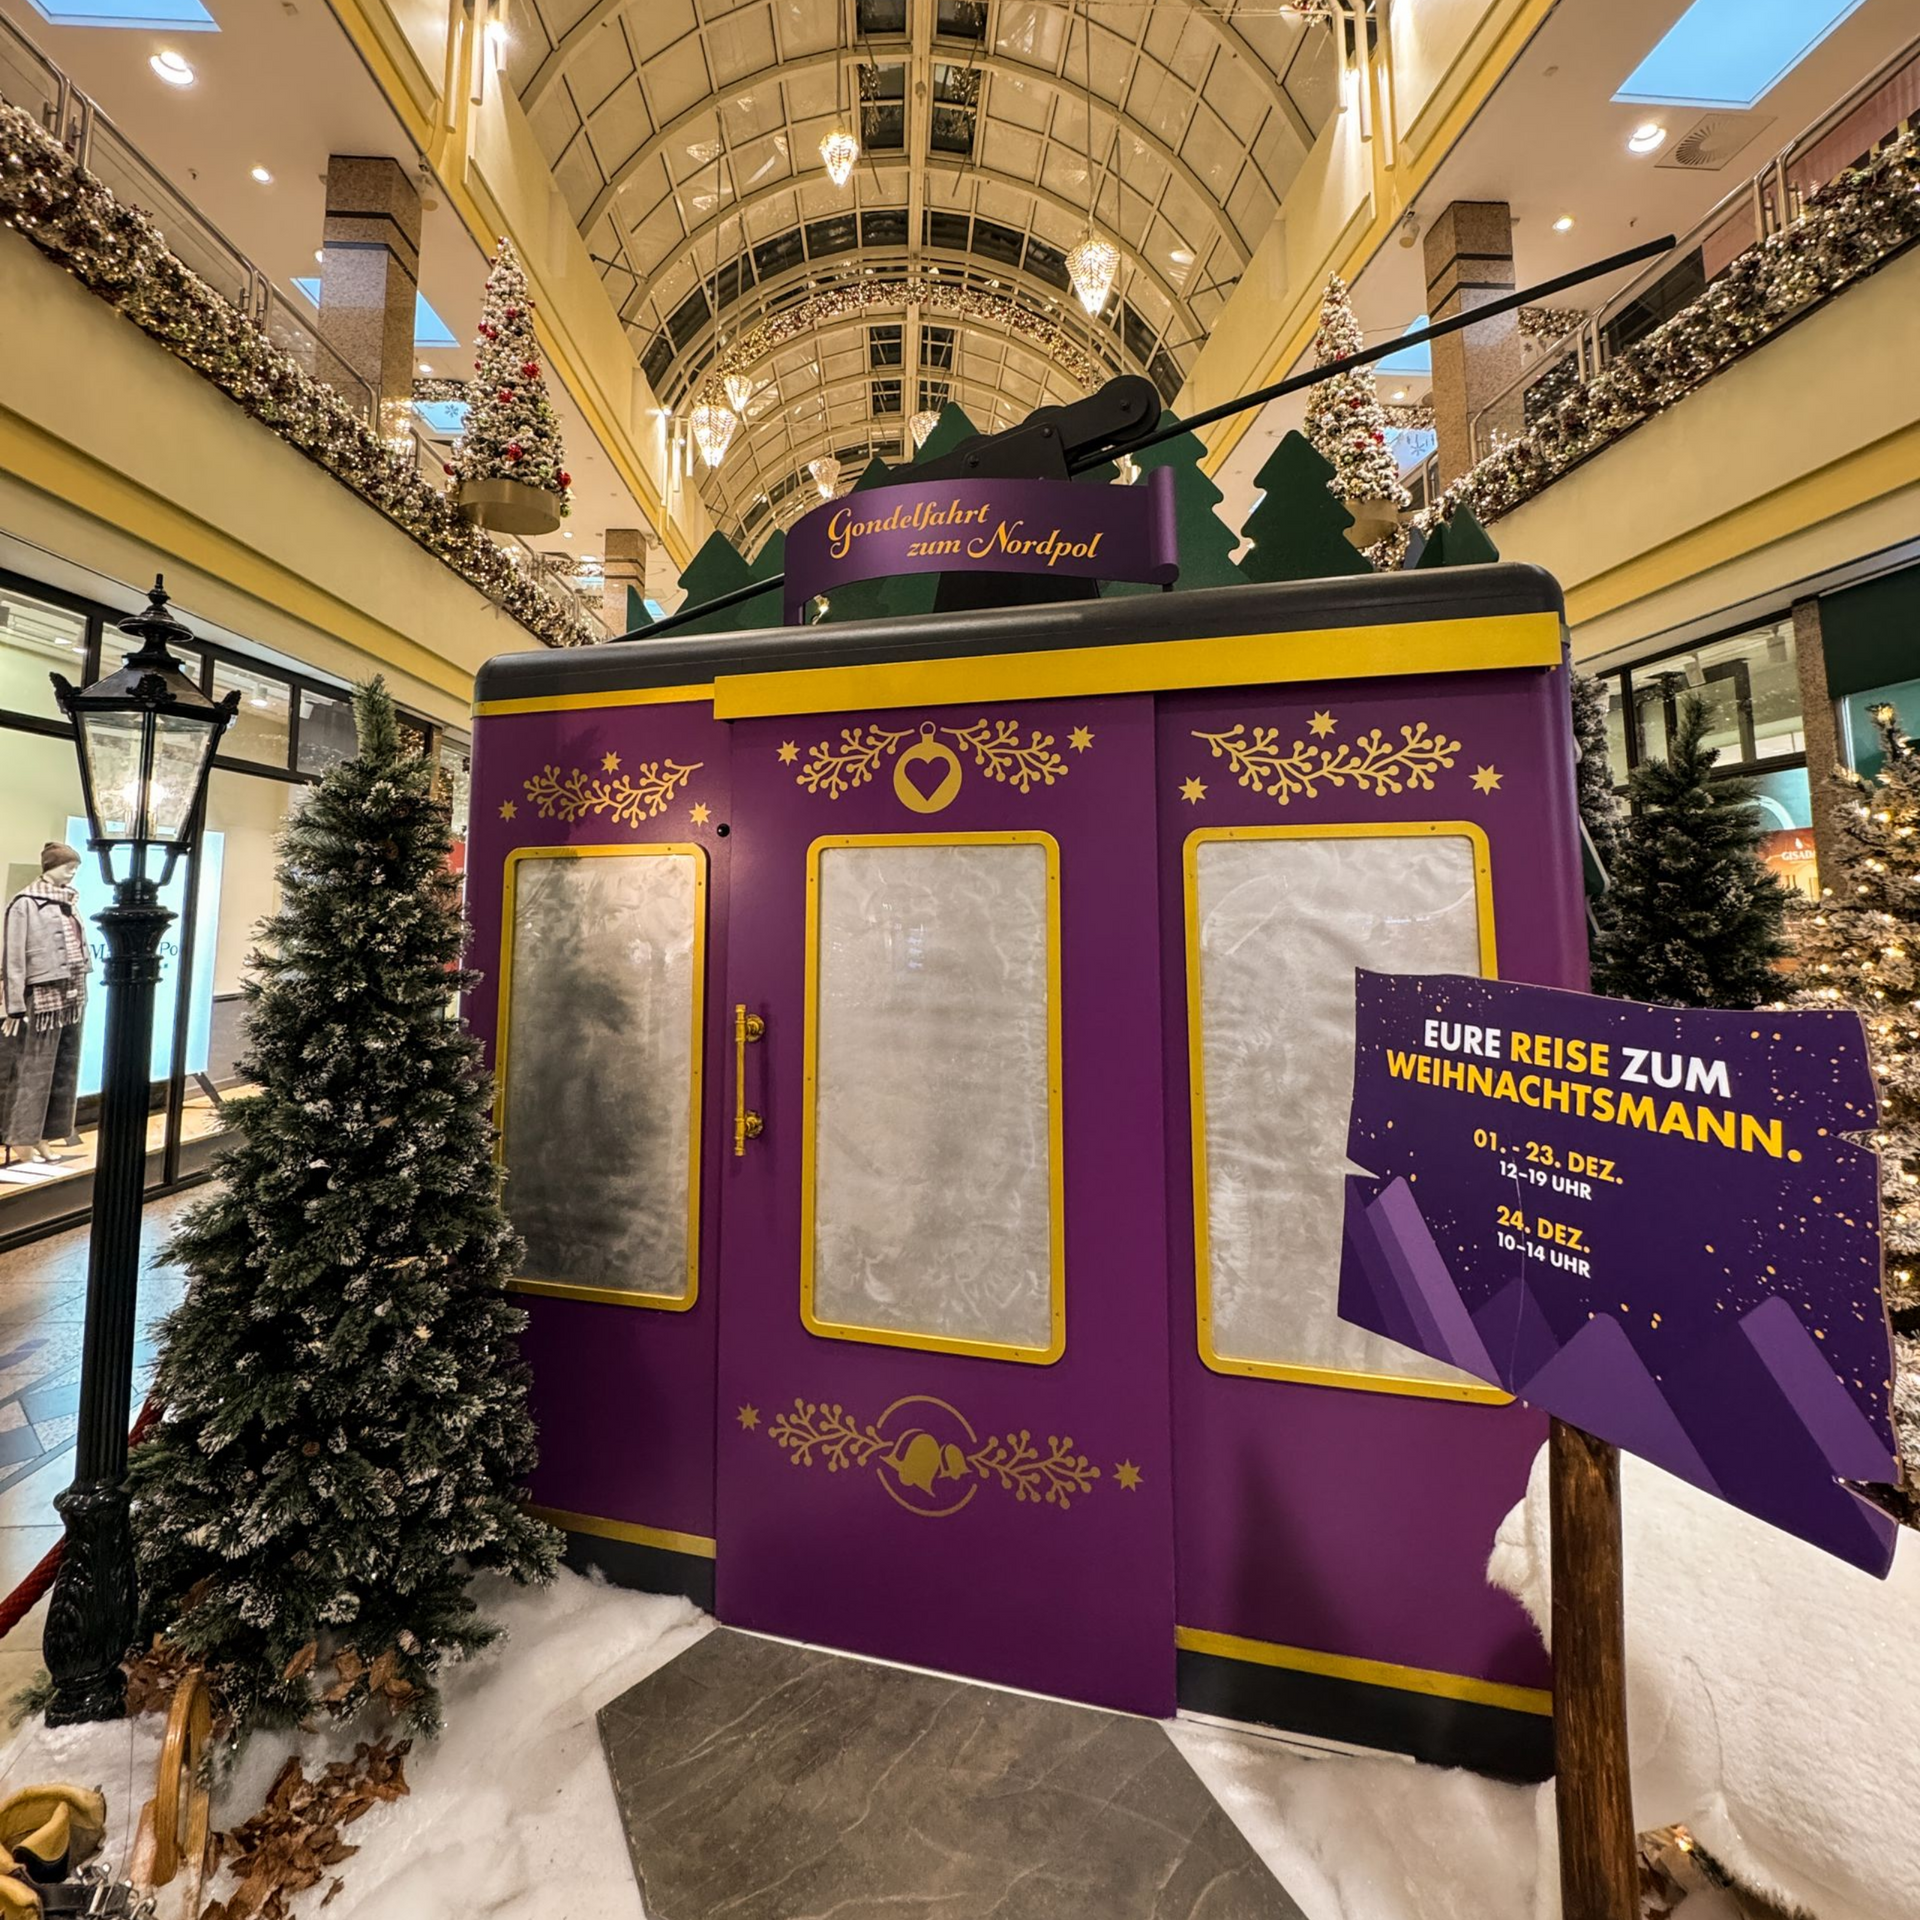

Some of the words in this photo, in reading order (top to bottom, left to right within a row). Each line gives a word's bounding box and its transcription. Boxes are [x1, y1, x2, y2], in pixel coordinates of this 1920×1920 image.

[827, 499, 990, 560] Gondelfahrt
[907, 541, 961, 557] zum
[967, 520, 1104, 567] Nordpol
[1424, 1019, 1501, 1059] EURE
[1510, 1031, 1610, 1077] REISE
[1620, 1046, 1732, 1098] ZUM
[1386, 1048, 1803, 1163] WEIHNACHTSMANN.
[1473, 1128, 1507, 1154] 01.
[1525, 1141, 1562, 1169] 23.
[1567, 1150, 1624, 1185] DEZ.
[1551, 1174, 1593, 1201] UHR
[1496, 1205, 1531, 1235] 24.
[1537, 1217, 1591, 1254] DEZ.
[1549, 1249, 1592, 1279] UHR
